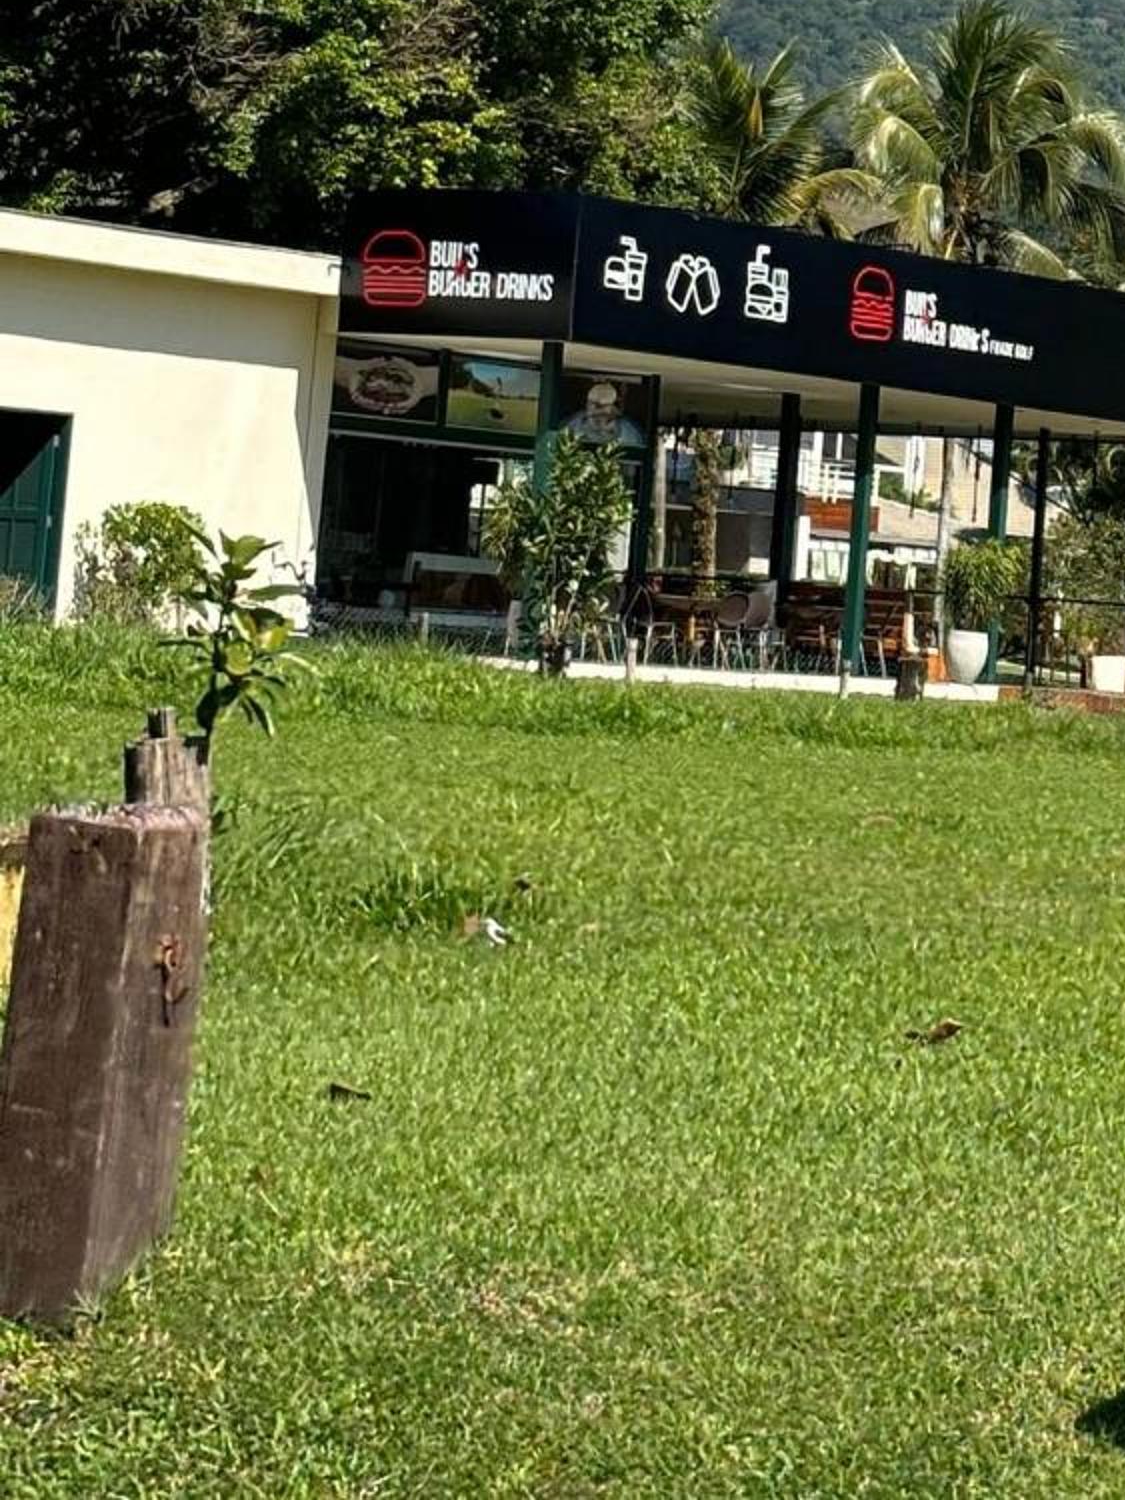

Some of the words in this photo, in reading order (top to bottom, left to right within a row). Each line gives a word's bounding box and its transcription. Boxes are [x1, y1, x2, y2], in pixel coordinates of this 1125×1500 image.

[428, 270, 490, 297] BURGER
[496, 273, 553, 300] DRINKS
[903, 317, 946, 346] BURGER
